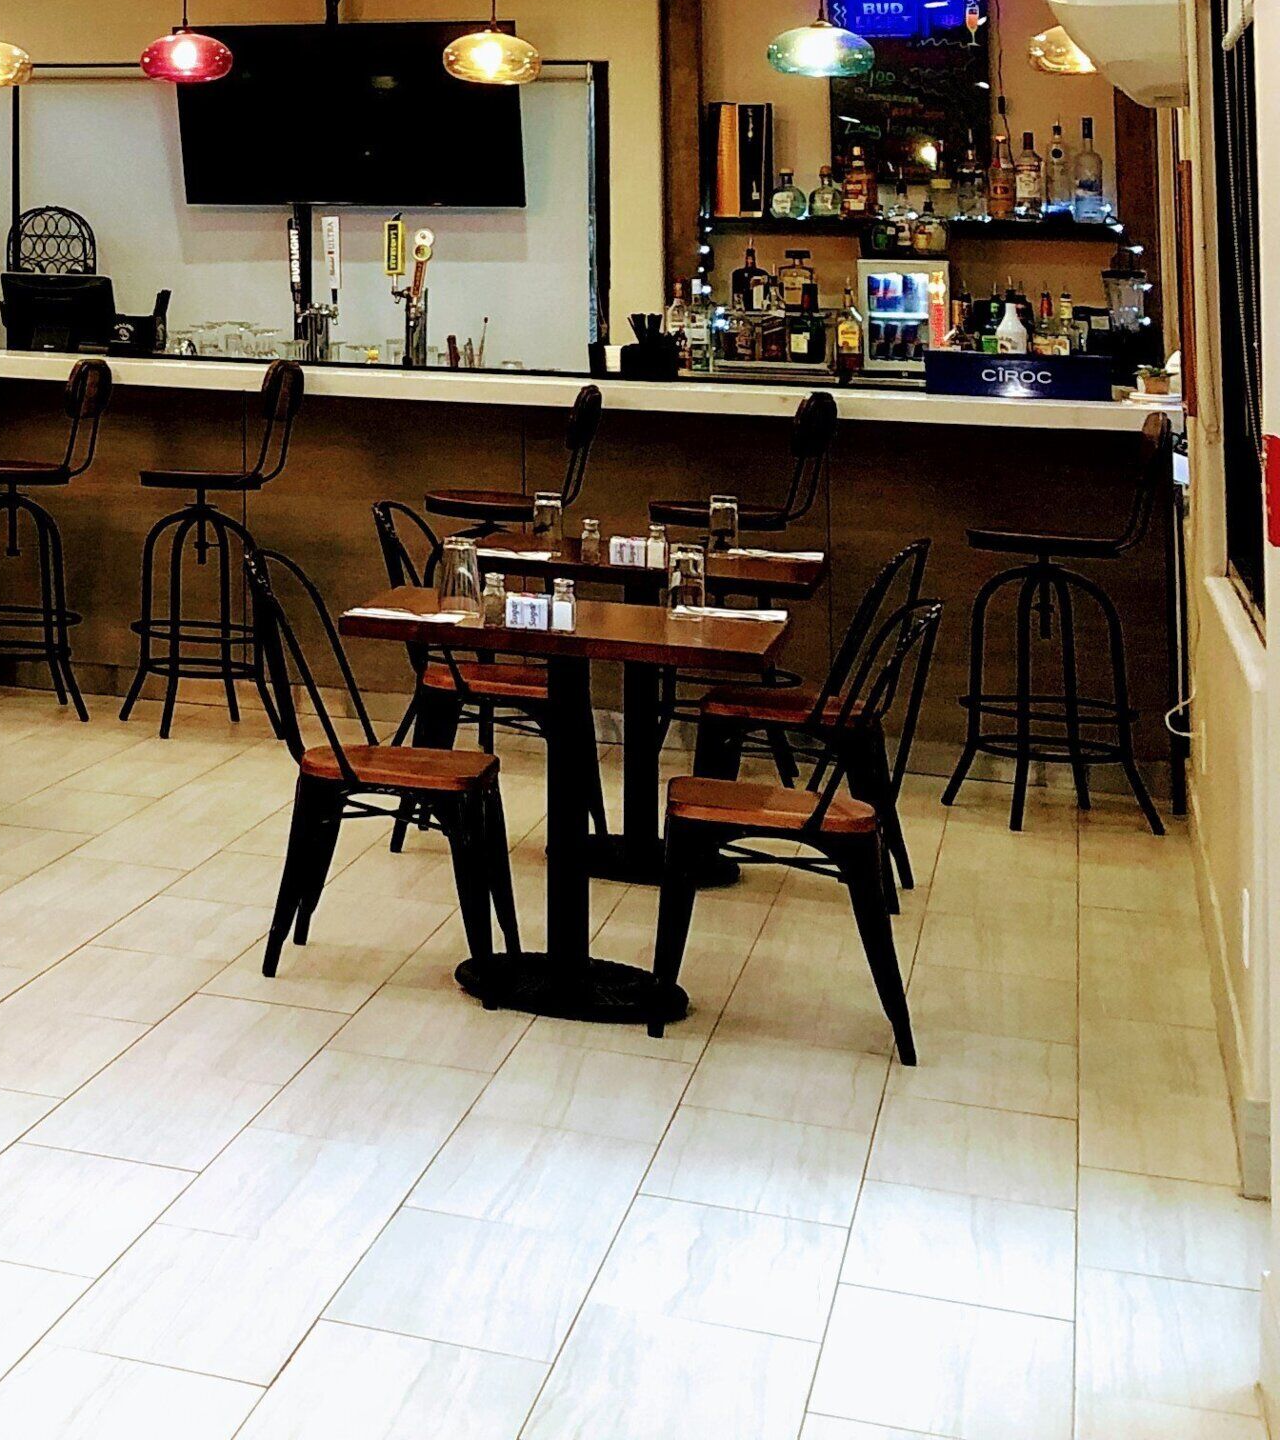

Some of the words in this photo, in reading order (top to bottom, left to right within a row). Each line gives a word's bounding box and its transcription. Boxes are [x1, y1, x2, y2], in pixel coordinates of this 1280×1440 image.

[862, 2, 904, 15] BUD
[290, 229, 300, 260] LIGHT
[291, 261, 301, 283] BUD
